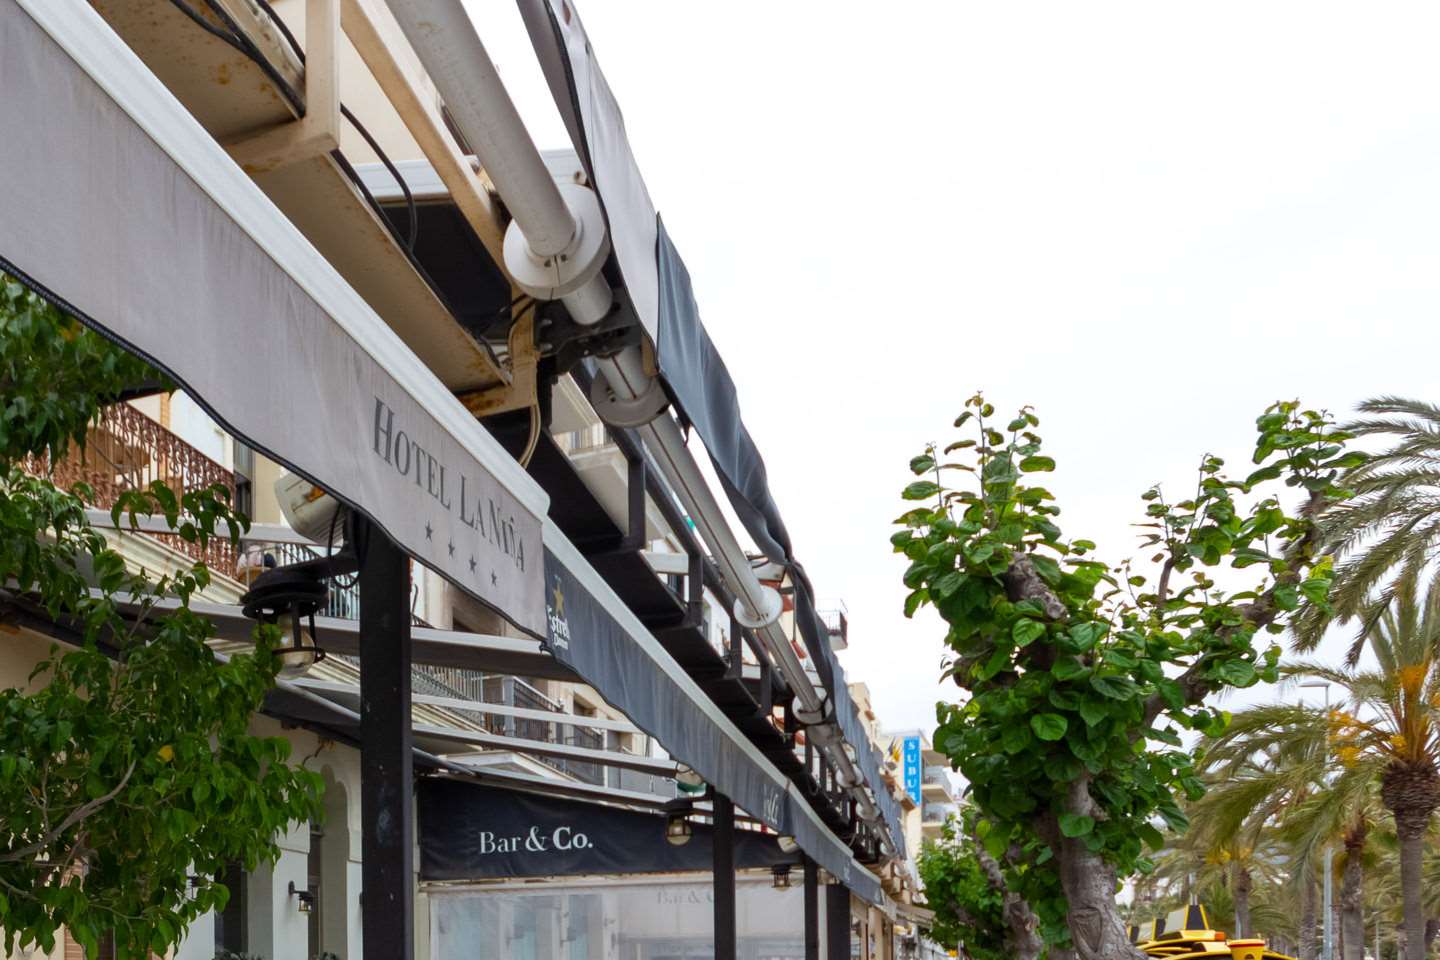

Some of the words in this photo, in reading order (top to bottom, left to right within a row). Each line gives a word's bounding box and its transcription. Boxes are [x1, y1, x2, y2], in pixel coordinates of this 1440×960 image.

[373, 397, 451, 511] HOTEL
[460, 474, 486, 539] LA
[479, 831, 522, 854] Bar
[525, 825, 548, 852] &
[551, 825, 594, 851] Co.
